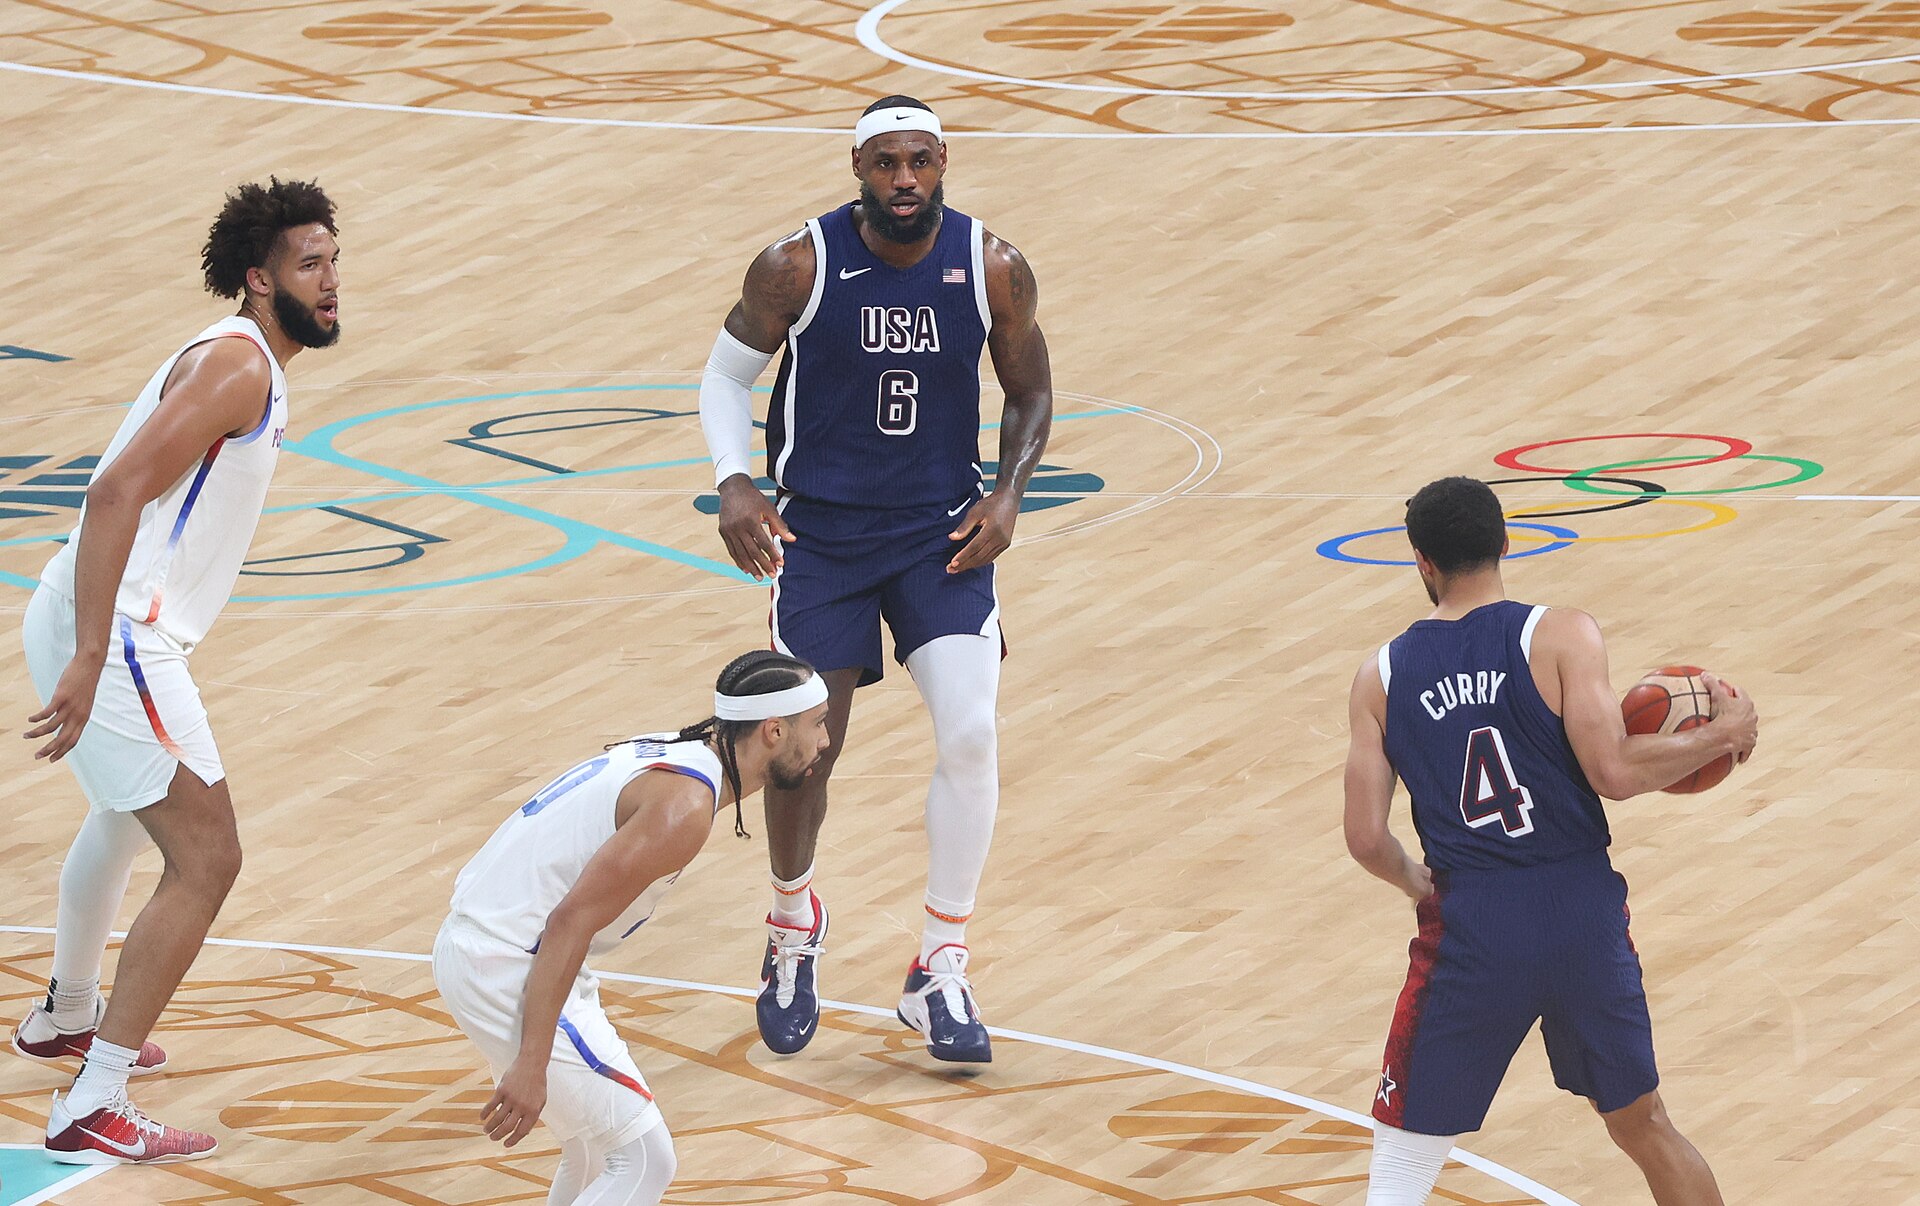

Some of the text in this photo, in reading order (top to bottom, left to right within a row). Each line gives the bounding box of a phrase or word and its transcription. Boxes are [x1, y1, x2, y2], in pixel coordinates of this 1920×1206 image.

[861, 306, 940, 353] USA
[877, 369, 919, 435] 6
[1420, 670, 1507, 720] CURRY
[1460, 726, 1534, 838] 4
